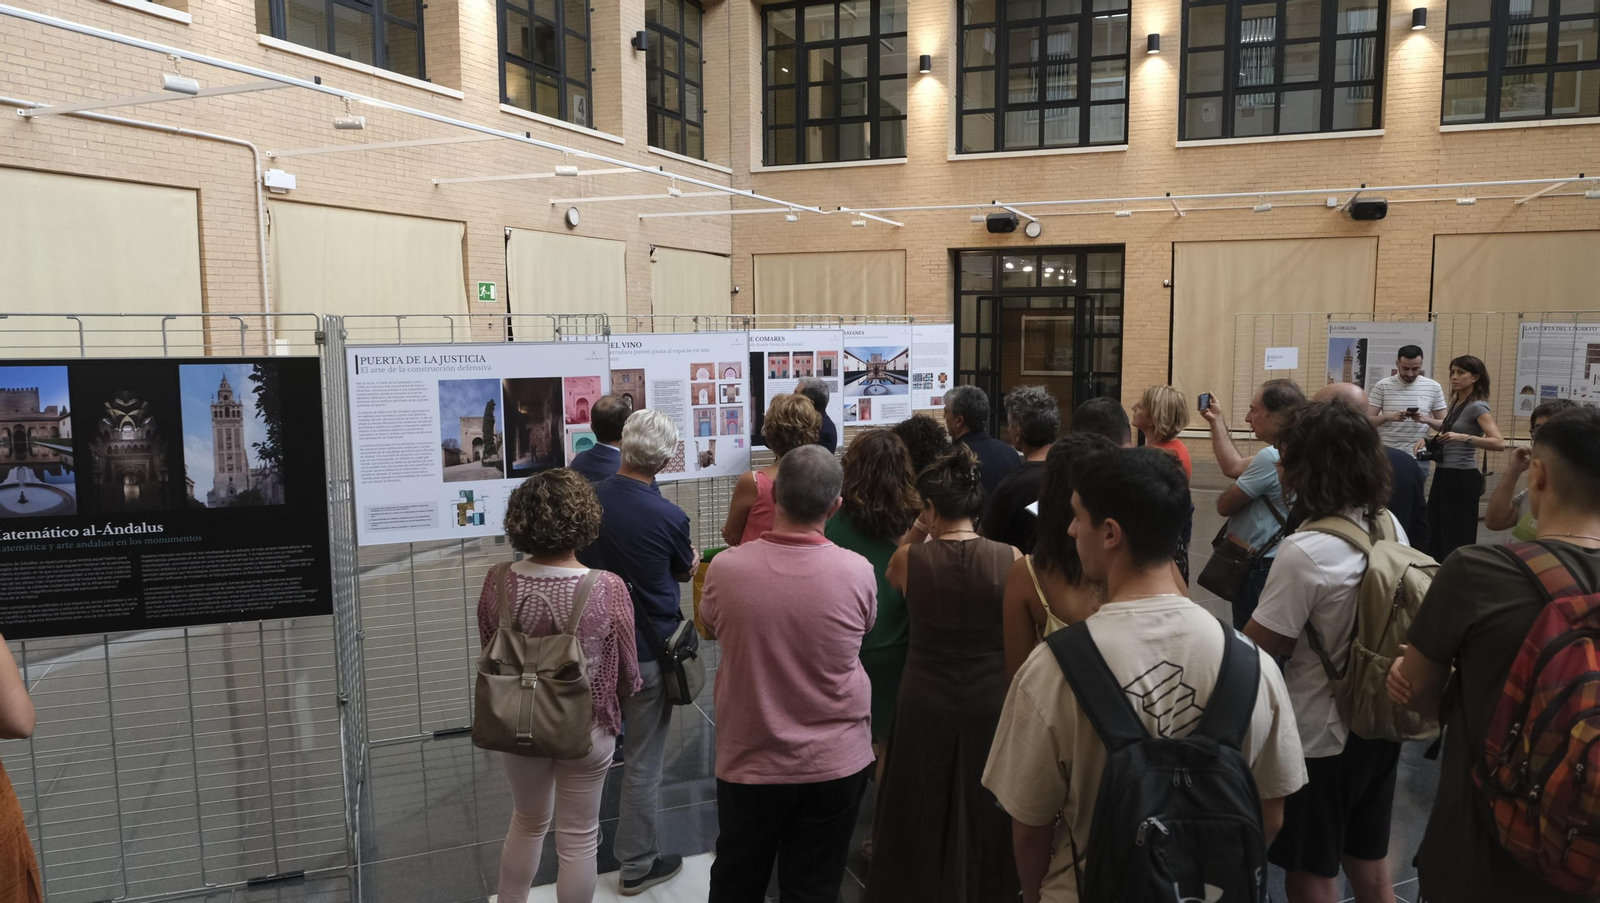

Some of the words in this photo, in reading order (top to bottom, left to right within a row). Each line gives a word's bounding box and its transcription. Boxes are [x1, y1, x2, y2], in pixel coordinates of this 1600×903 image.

[360, 356, 404, 365] PUERTA
[406, 355, 421, 364] DE
[424, 355, 438, 364] LA
[439, 354, 486, 365] JUSTICIA
[0, 527, 79, 541] atemático
[82, 522, 164, 537] al-Ándalus
[49, 544, 54, 552] y
[76, 538, 114, 548] andalusí
[129, 537, 142, 545] los
[144, 534, 202, 544] monumentos
